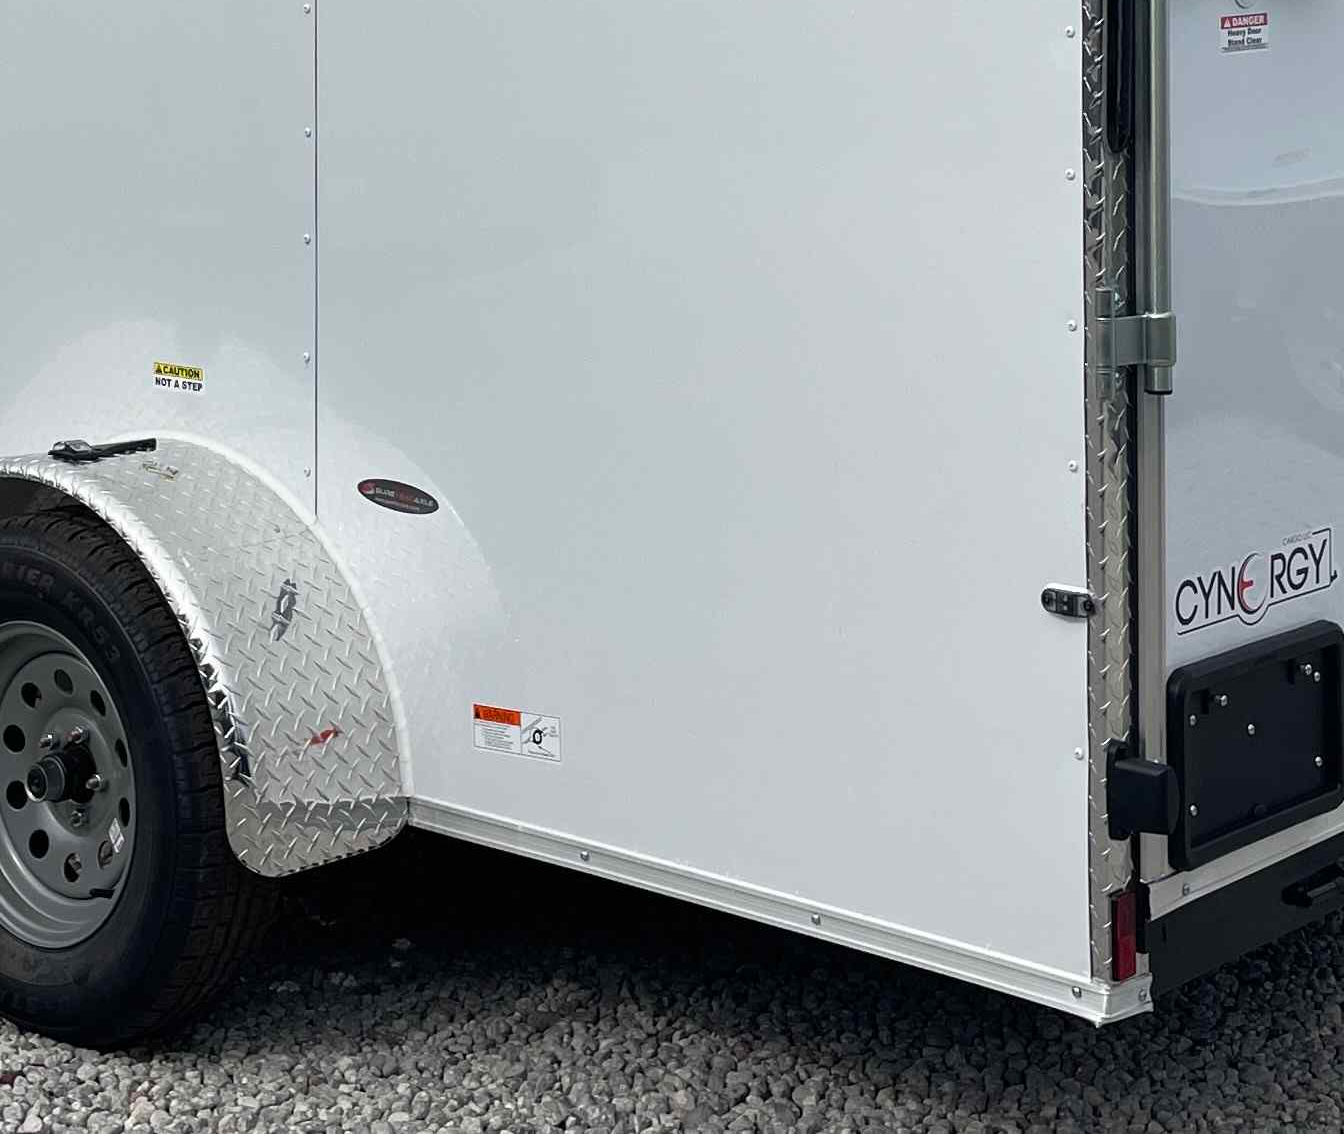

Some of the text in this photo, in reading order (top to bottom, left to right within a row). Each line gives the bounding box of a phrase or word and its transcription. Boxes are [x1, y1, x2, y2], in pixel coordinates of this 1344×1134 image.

[1232, 15, 1265, 27] DANGER
[163, 366, 200, 378] CAUTION
[155, 377, 203, 392] NOT A STEP
[1175, 538, 1328, 626] CYNERGY
